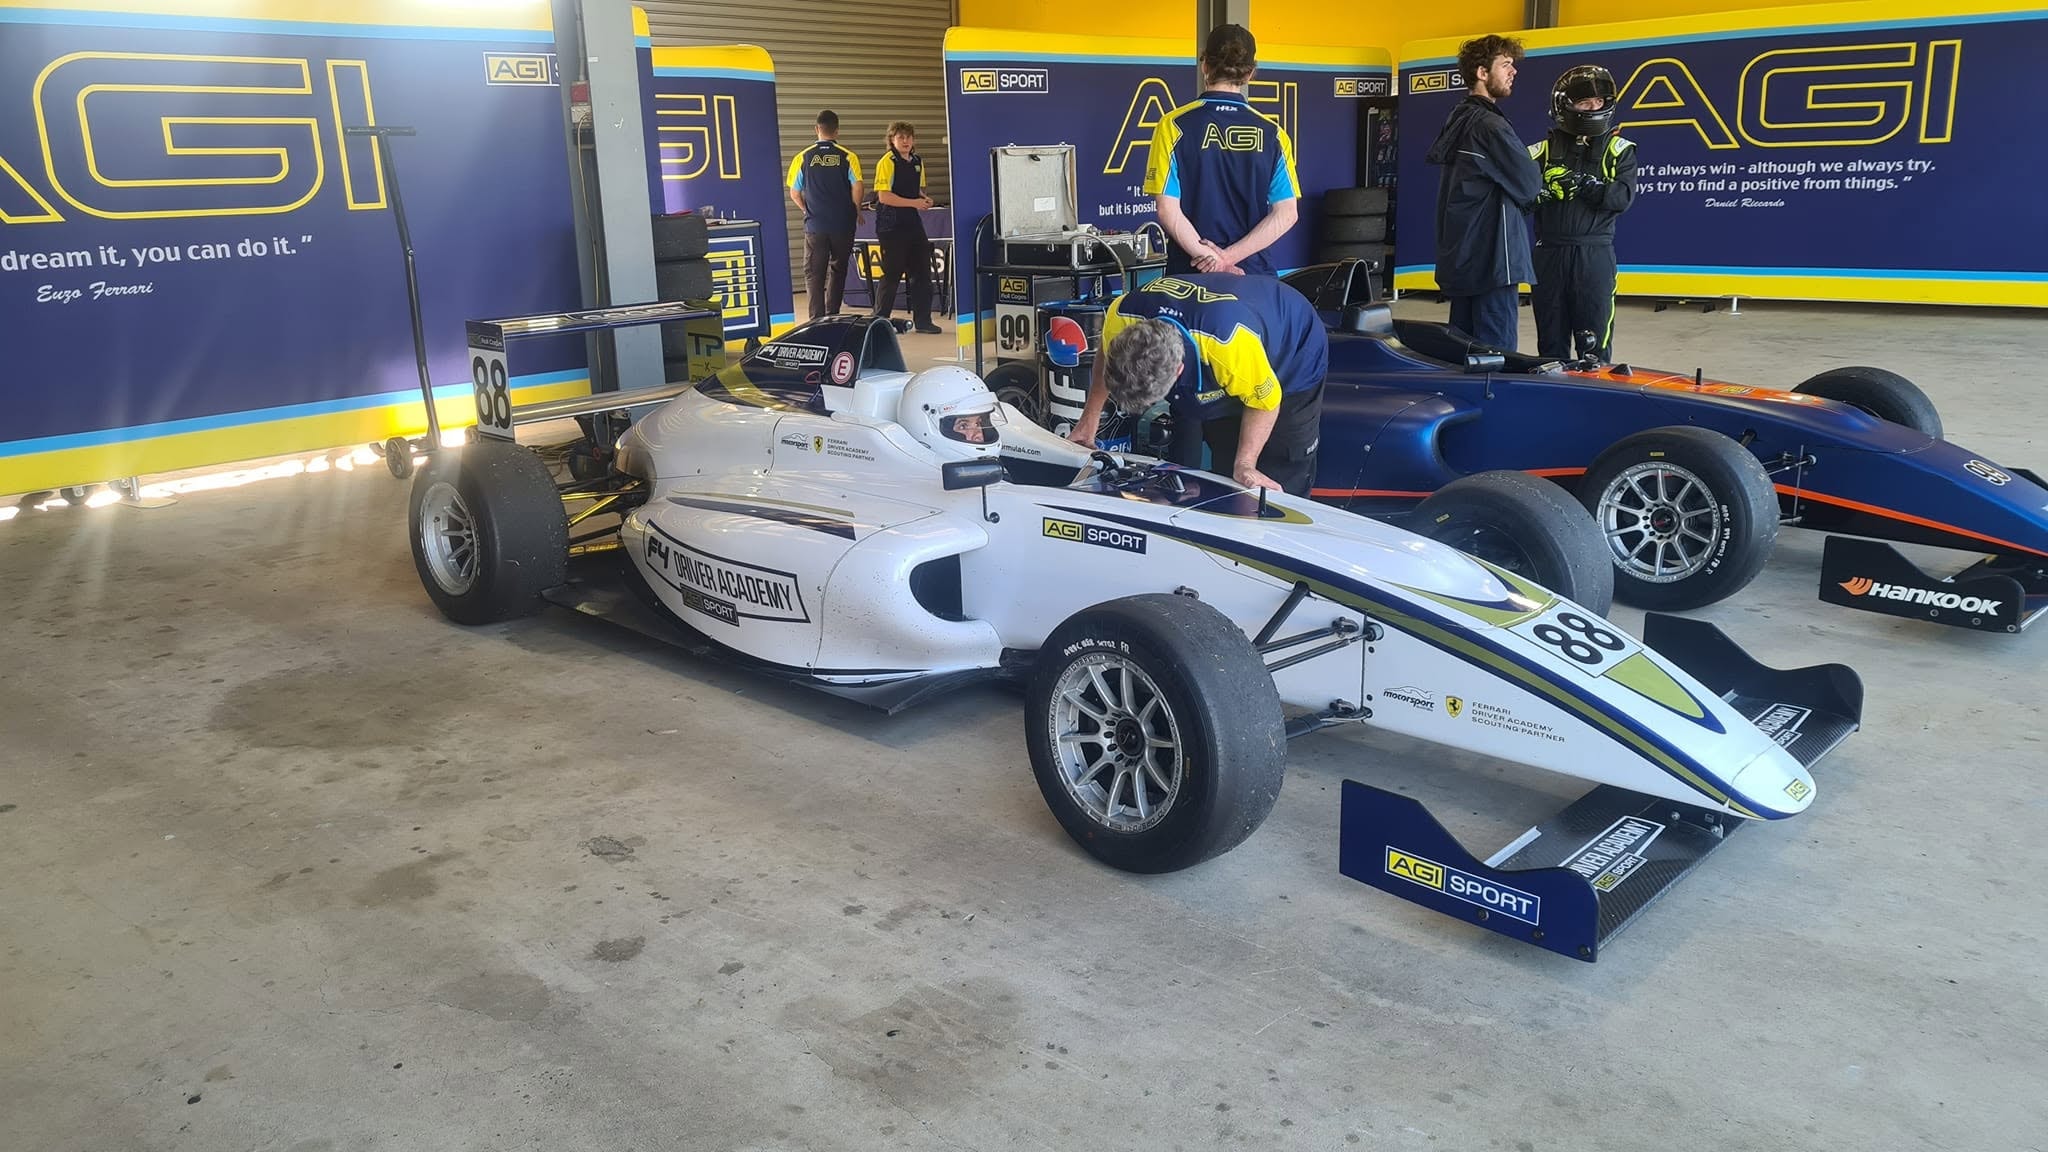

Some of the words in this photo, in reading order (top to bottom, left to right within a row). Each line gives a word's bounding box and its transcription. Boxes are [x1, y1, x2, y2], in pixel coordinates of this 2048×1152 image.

[494, 60, 544, 79] AGI
[966, 74, 994, 89] AGI
[1000, 74, 1045, 88] SPORT
[1337, 80, 1355, 92] AGI
[1358, 82, 1385, 93] SPORT
[1413, 76, 1445, 89] AGI
[1614, 39, 1962, 149] AGI
[0, 51, 388, 224] GI
[1201, 123, 1264, 152] AGI
[810, 155, 840, 166] AGI
[1658, 164, 1706, 177] always
[1709, 162, 1736, 174] win
[1748, 160, 1816, 175] although
[1820, 162, 1843, 172] we
[1847, 159, 1904, 174] always
[1907, 158, 1936, 173] try.
[1134, 185, 1141, 197] It
[1657, 181, 1677, 194] try
[1680, 180, 1695, 192] to
[1697, 179, 1725, 191] find
[1728, 181, 1738, 190] a
[1741, 177, 1800, 192] positive
[1804, 177, 1841, 190] from
[1845, 176, 1899, 191] things.
[1099, 204, 1114, 216] but
[1116, 203, 1122, 215] it
[1124, 202, 1131, 215] is
[1705, 198, 1738, 208] Daniel
[1, 249, 93, 271] dream
[99, 245, 127, 267] it,
[132, 244, 182, 267] you
[187, 240, 231, 260] can
[237, 238, 267, 258] do
[89, 281, 154, 301] Ferrari
[1003, 280, 1025, 291] AGI
[1001, 314, 1030, 351] 99
[777, 346, 797, 359] DRIVER
[797, 347, 824, 362] ACADEMY
[837, 359, 849, 376] E
[473, 356, 511, 430] 88
[827, 450, 852, 458] SCOUTING
[852, 453, 875, 461] PARTNER
[845, 447, 870, 455] ACADEMY
[1046, 522, 1080, 539] AGI
[1087, 528, 1143, 549] SPORT
[647, 535, 669, 569] F4
[673, 550, 718, 593] DRIVER
[718, 567, 793, 611] ACADEMY
[703, 599, 734, 619] SPORT
[1533, 612, 1626, 665] 88
[1383, 690, 1435, 709] motorsport
[1472, 701, 1511, 715] FERRARI
[1471, 716, 1519, 733] SCOUTING
[1521, 727, 1566, 743] PARTNER
[1472, 709, 1506, 722] DRIVER
[1507, 717, 1554, 732] ACADEMY
[1593, 820, 1652, 857] ACADEMY
[1612, 856, 1639, 875] SPORT
[1392, 857, 1439, 885] AGI
[1450, 875, 1533, 915] SPORT
